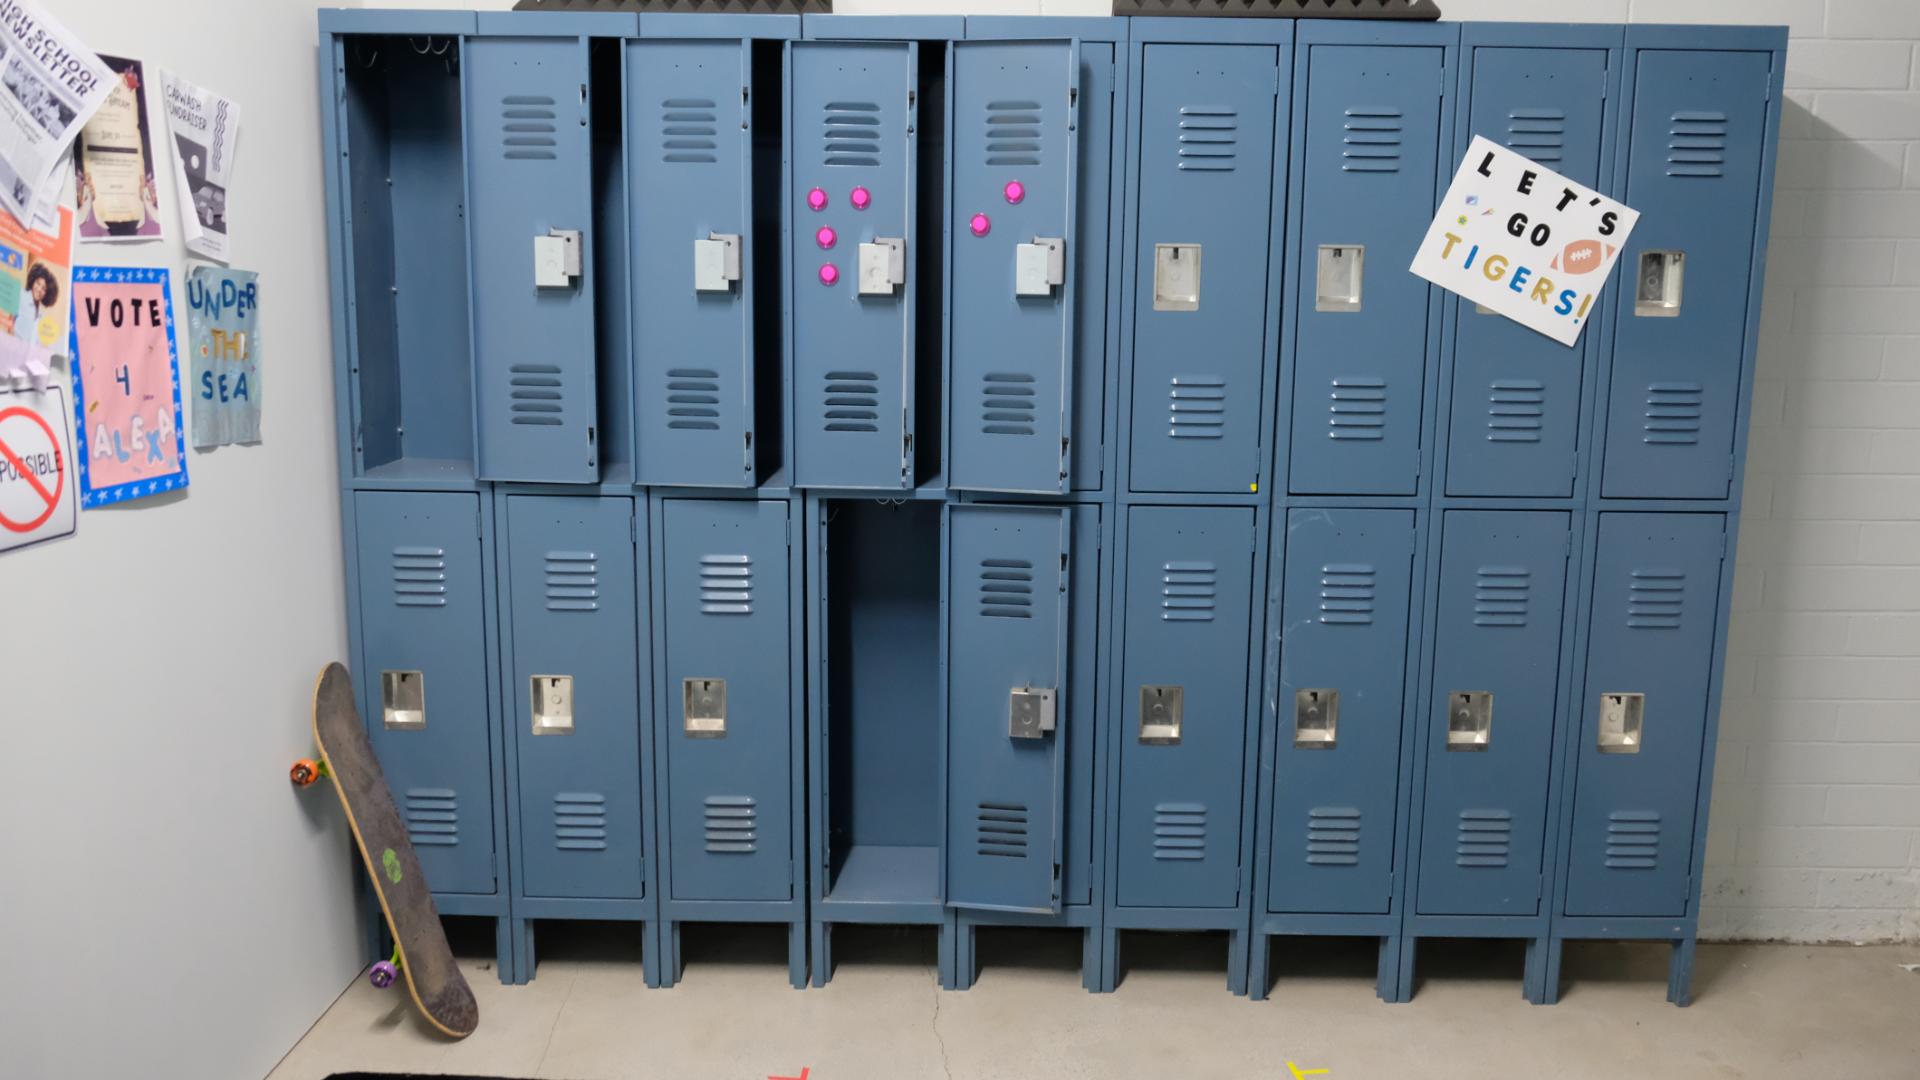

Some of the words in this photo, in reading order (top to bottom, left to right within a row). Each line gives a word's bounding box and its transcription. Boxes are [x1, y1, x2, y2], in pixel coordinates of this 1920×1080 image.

[3, 0, 34, 31] IGH
[35, 29, 98, 91] SCHOOL
[166, 85, 202, 111] CARWASH
[1477, 151, 1618, 236] LET'S
[1507, 213, 1551, 247] GO
[1441, 232, 1592, 324] TIGERS!
[86, 297, 161, 328] VOTE
[188, 279, 257, 320] UNDER
[116, 365, 130, 395] 4
[201, 371, 248, 403] SEA
[93, 407, 175, 464] ALEXA
